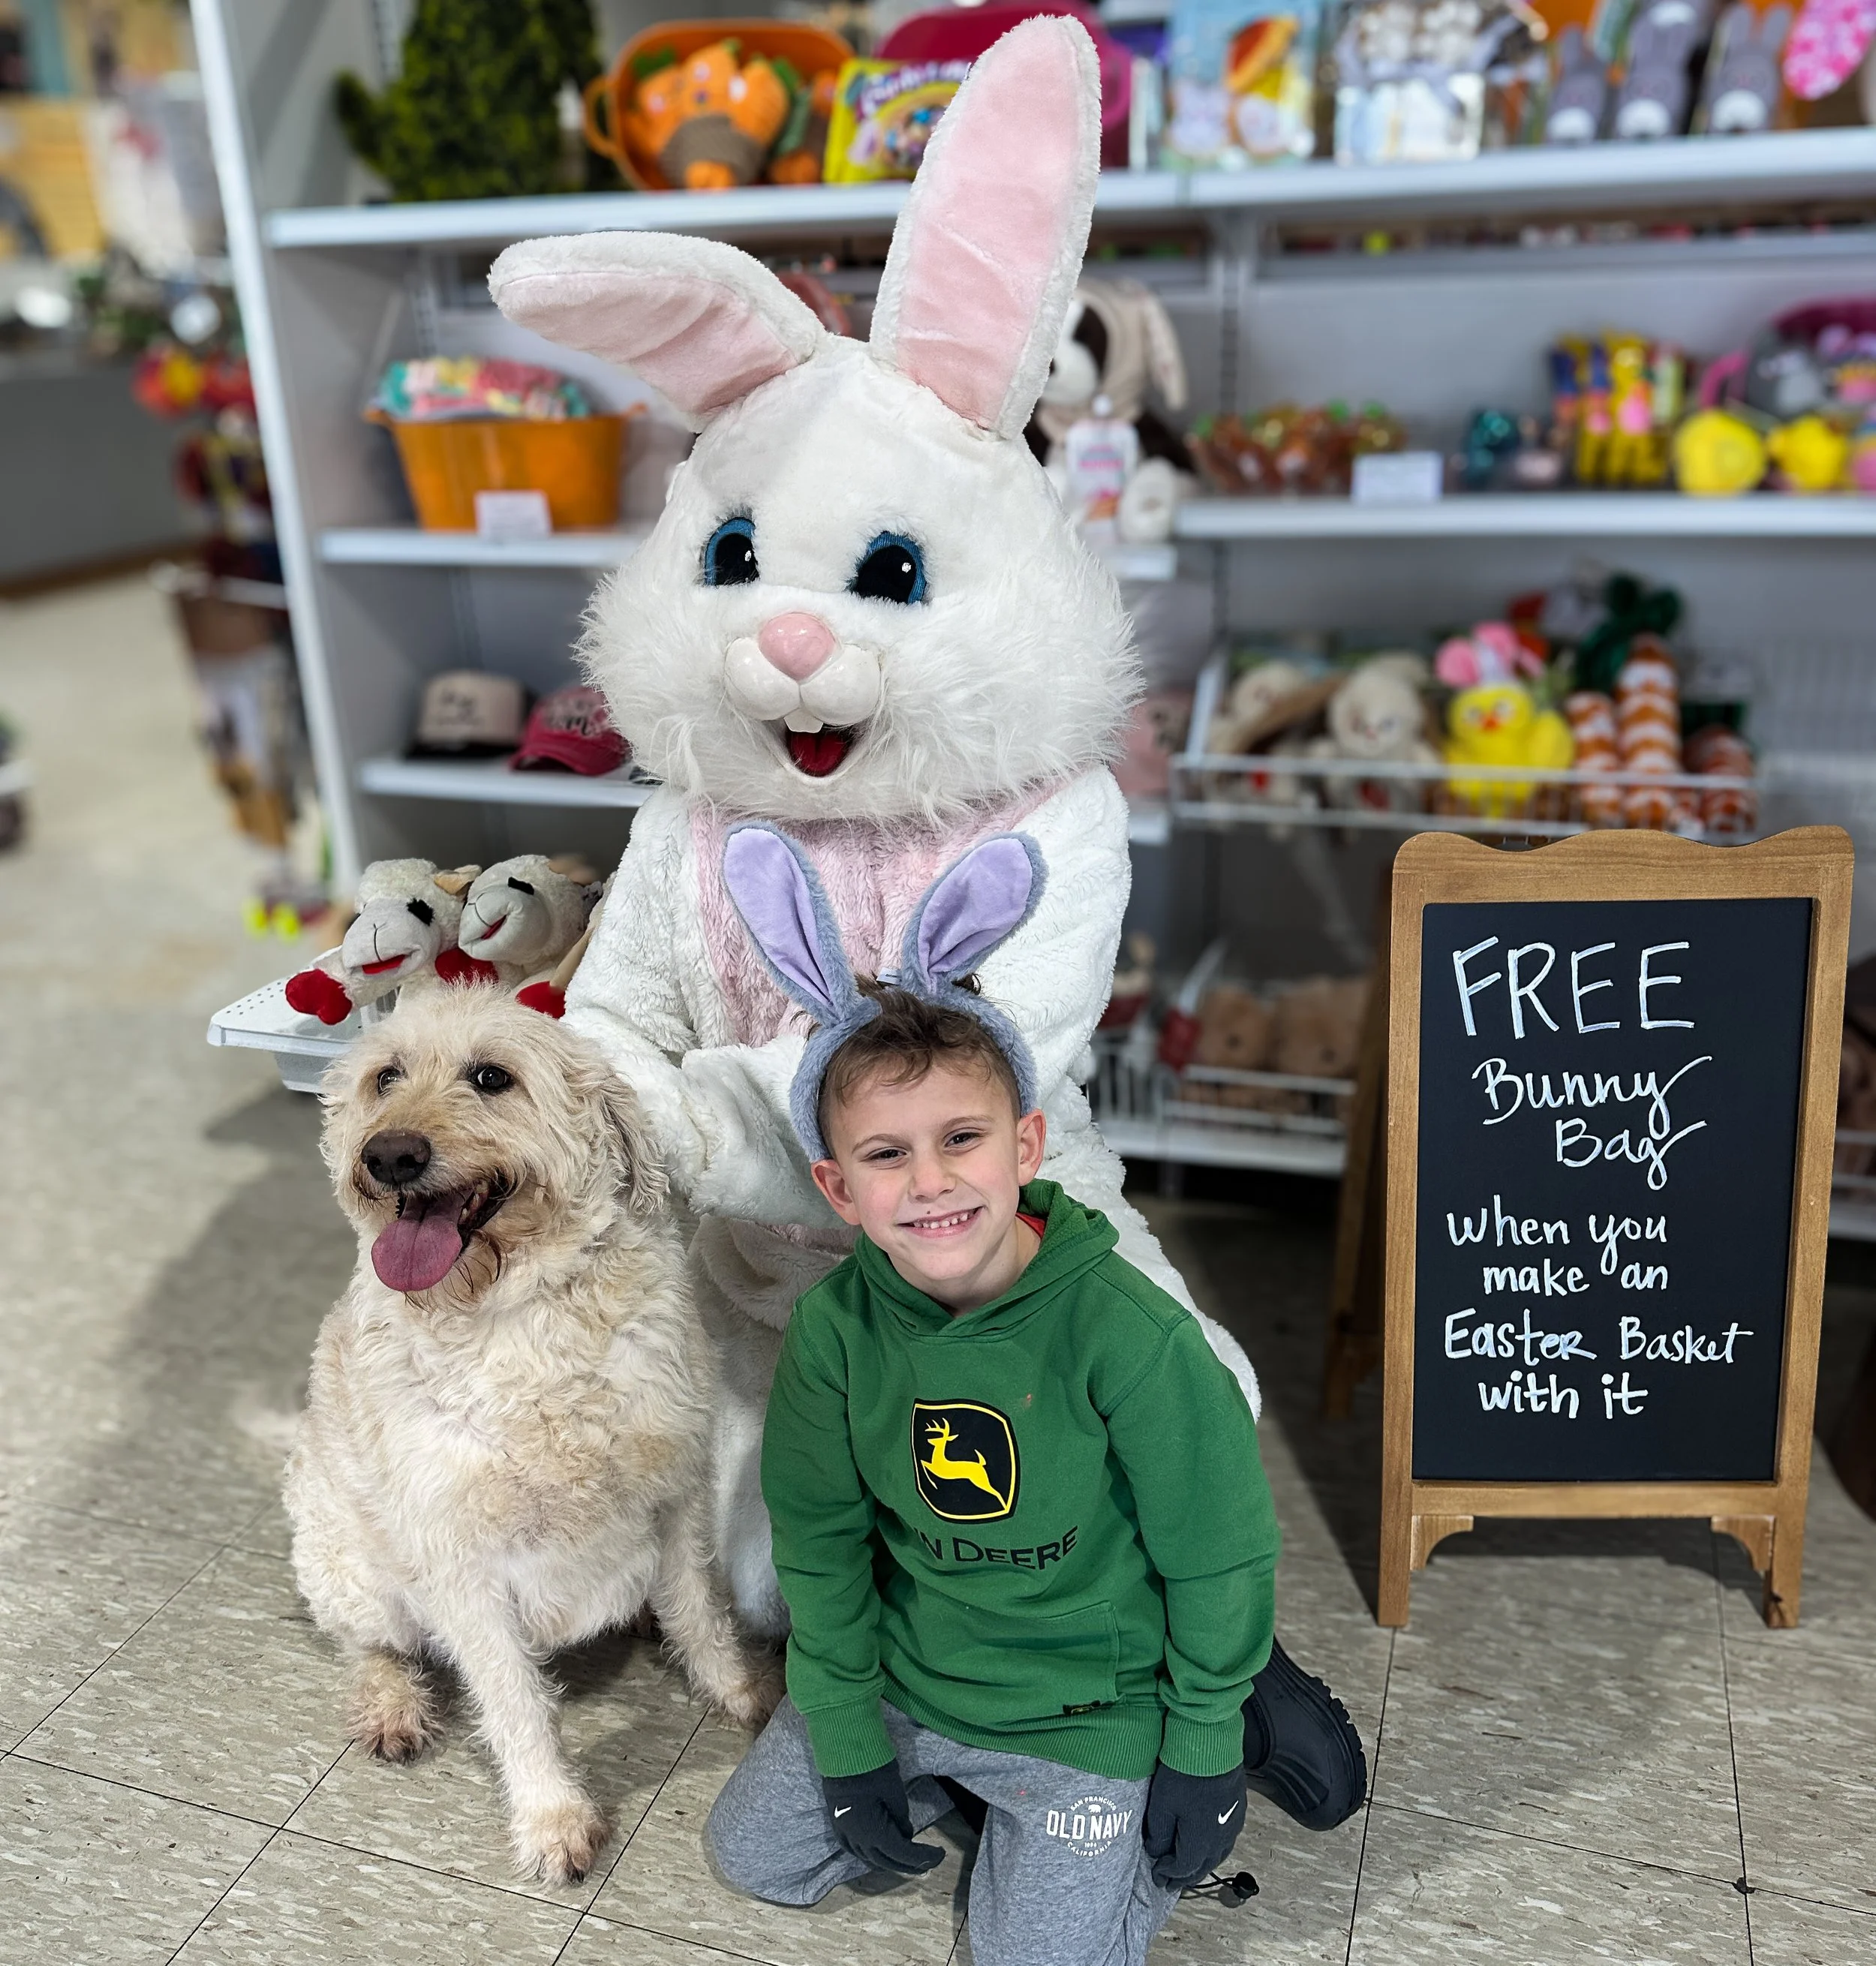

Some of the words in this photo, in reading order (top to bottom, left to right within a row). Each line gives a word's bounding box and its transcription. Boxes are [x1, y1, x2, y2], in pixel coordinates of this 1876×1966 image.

[1453, 936, 1694, 1039] FREE
[1472, 1056, 1712, 1140] Bunny
[1556, 1118, 1706, 1190] Bag
[1589, 1215, 1667, 1275] you
[1484, 1258, 1589, 1296] make
[1621, 1262, 1667, 1291] an
[1619, 1316, 1754, 1363] Basket
[1478, 1370, 1579, 1419] with
[1601, 1372, 1648, 1419] it
[952, 1526, 1078, 1570] DEERE
[1046, 1809, 1086, 1840] OLD
[1089, 1809, 1132, 1840] NAVY
[1070, 1799, 1084, 1811] SAN
[1084, 1796, 1117, 1811] FRANCISCO
[1068, 1841, 1111, 1856] CALIFORNIA
